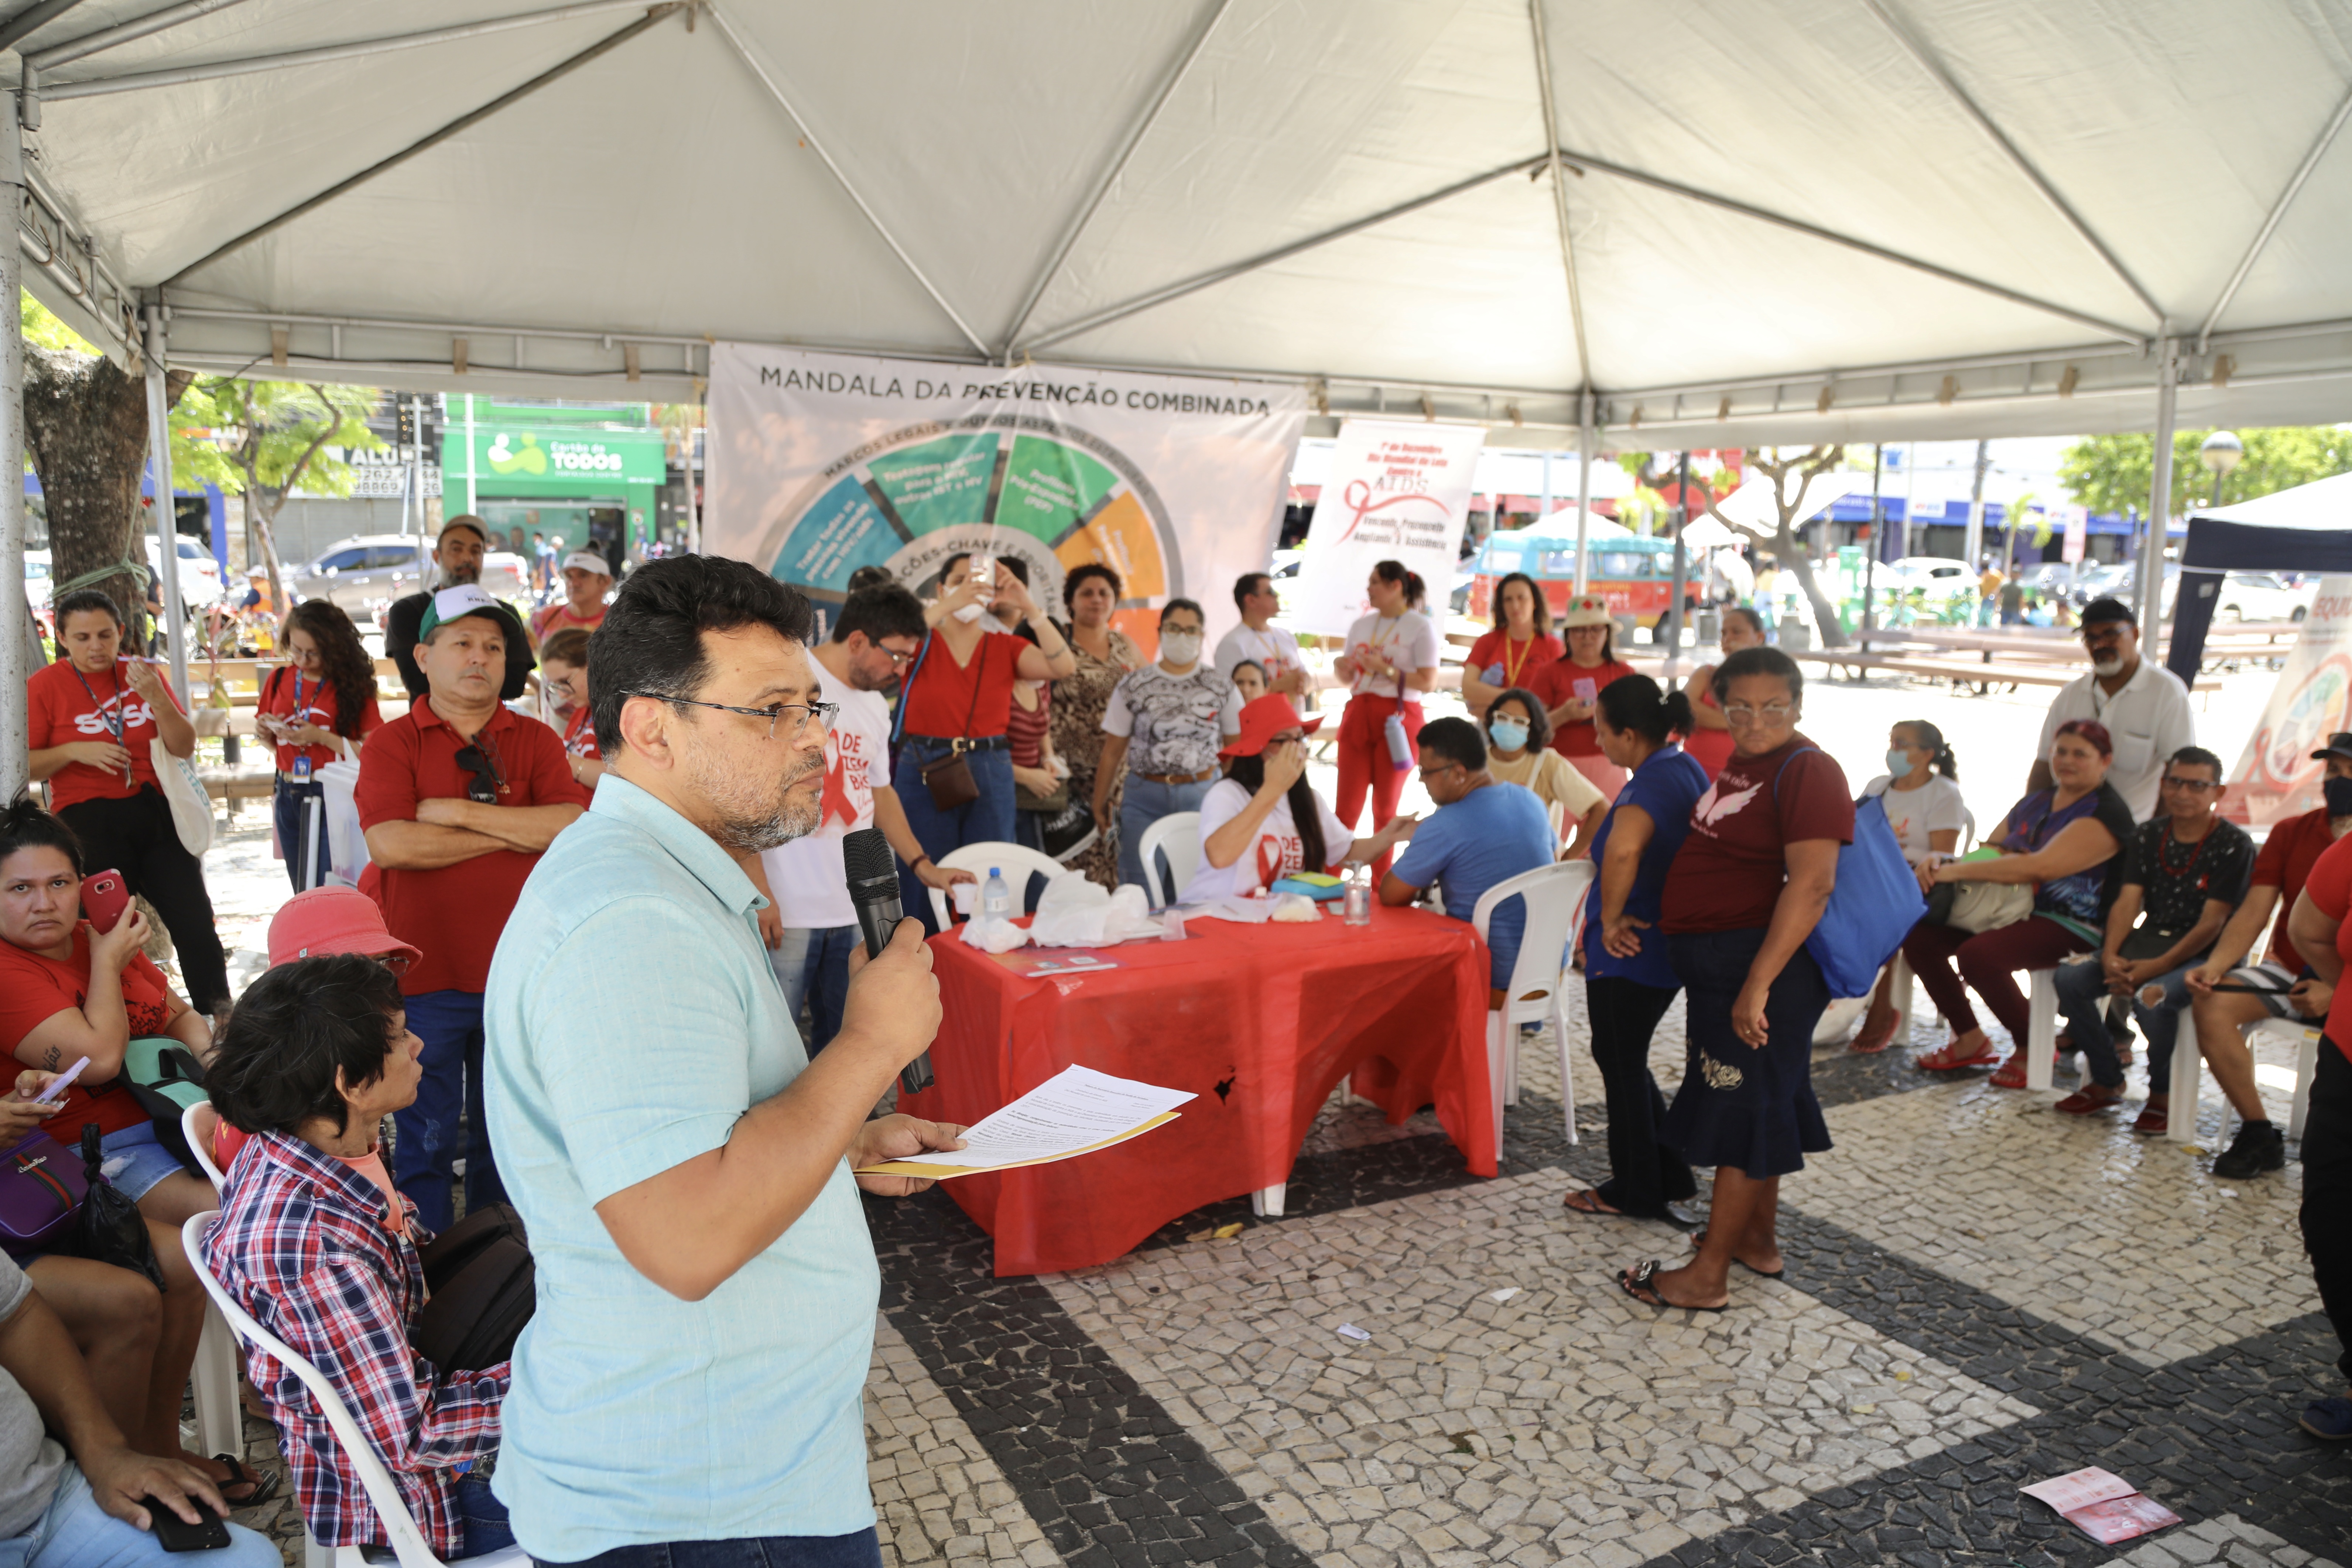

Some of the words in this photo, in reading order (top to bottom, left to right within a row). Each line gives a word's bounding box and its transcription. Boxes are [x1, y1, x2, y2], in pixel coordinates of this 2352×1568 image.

[760, 366, 904, 398] MANDALA
[915, 380, 952, 399] DA
[962, 381, 1119, 405] PREVENÇÃO
[1127, 390, 1271, 417] COMBINADA
[550, 440, 589, 454] Cartão
[591, 442, 606, 454] de
[825, 441, 883, 479] MARCOS
[887, 424, 940, 444] LEGAIS
[550, 452, 623, 471] TODOS
[882, 463, 942, 482] Testagem
[904, 477, 933, 492] para
[1373, 475, 1429, 495] AIDS
[795, 539, 823, 571] Tratar
[894, 539, 1002, 582] AÇÕES-CHAVE
[842, 732, 861, 753] DE
[1282, 836, 1302, 851] DE
[1284, 854, 1303, 870] ZE
